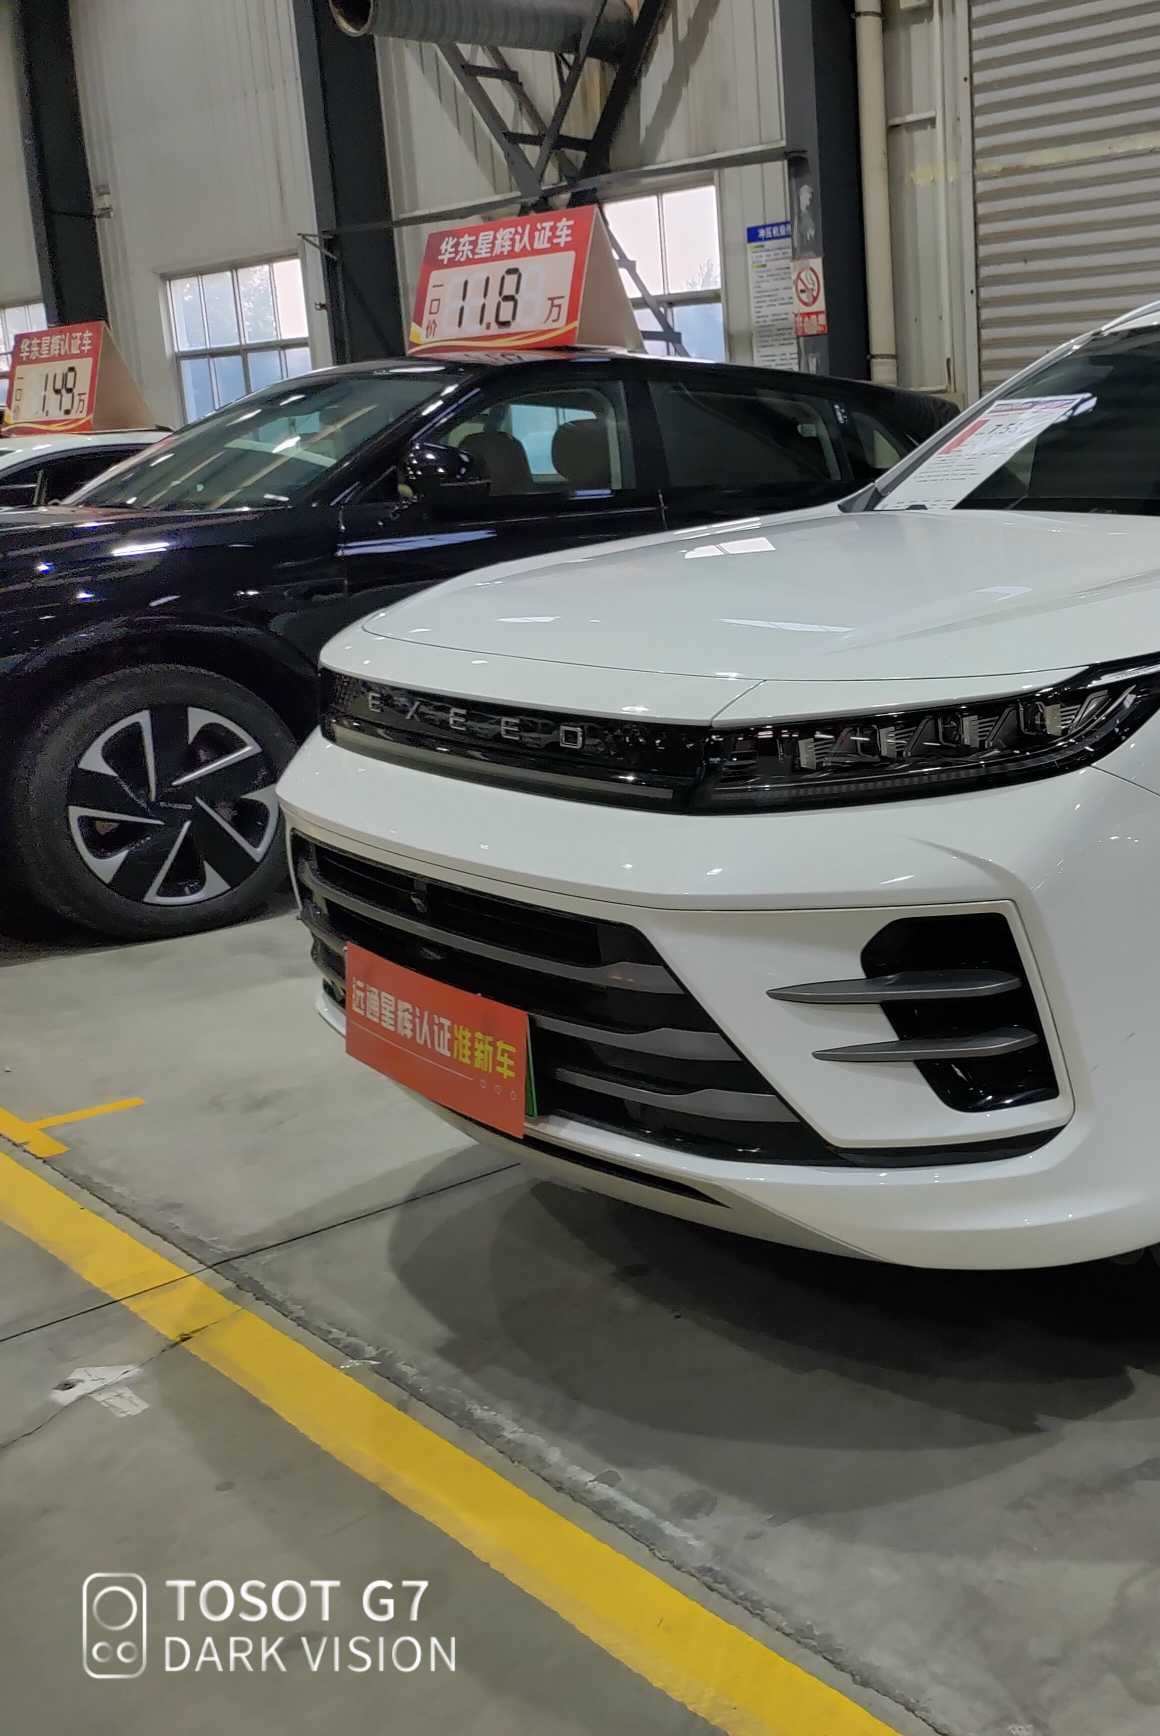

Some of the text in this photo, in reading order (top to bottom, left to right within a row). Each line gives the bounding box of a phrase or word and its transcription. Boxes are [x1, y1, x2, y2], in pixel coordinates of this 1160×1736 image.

[438, 217, 575, 264] 华东星辉认证车
[457, 267, 565, 330] 11.8 万
[20, 330, 93, 361] 华东星辉认证车
[42, 366, 76, 416] 1.49
[367, 691, 585, 750] EXEED
